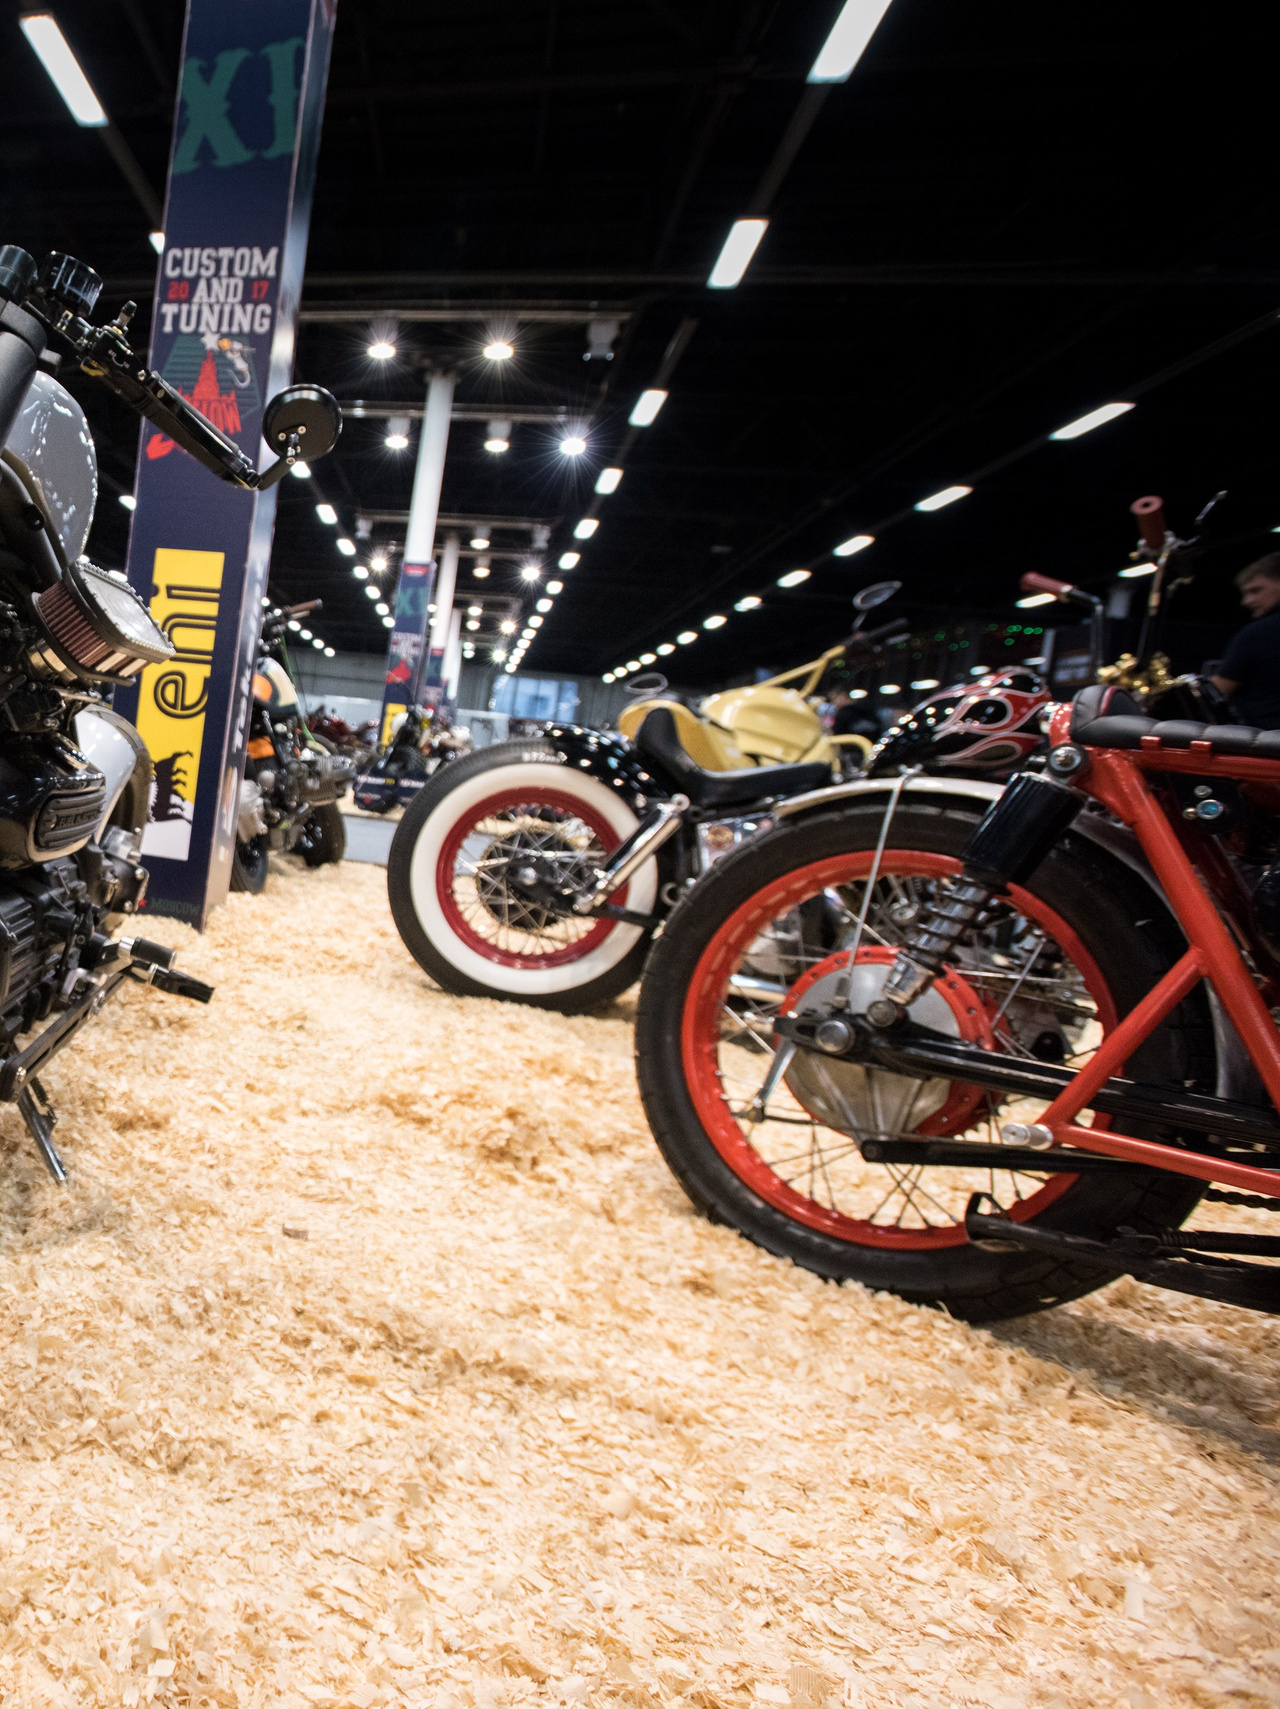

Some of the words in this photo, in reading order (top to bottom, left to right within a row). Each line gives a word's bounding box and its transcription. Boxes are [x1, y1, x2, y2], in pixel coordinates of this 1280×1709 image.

[165, 247, 279, 278] CUSTOM
[167, 280, 190, 299] 20
[191, 276, 244, 304] AND
[251, 280, 270, 299] 17
[161, 302, 272, 334] TUNING
[152, 583, 220, 720] eni
